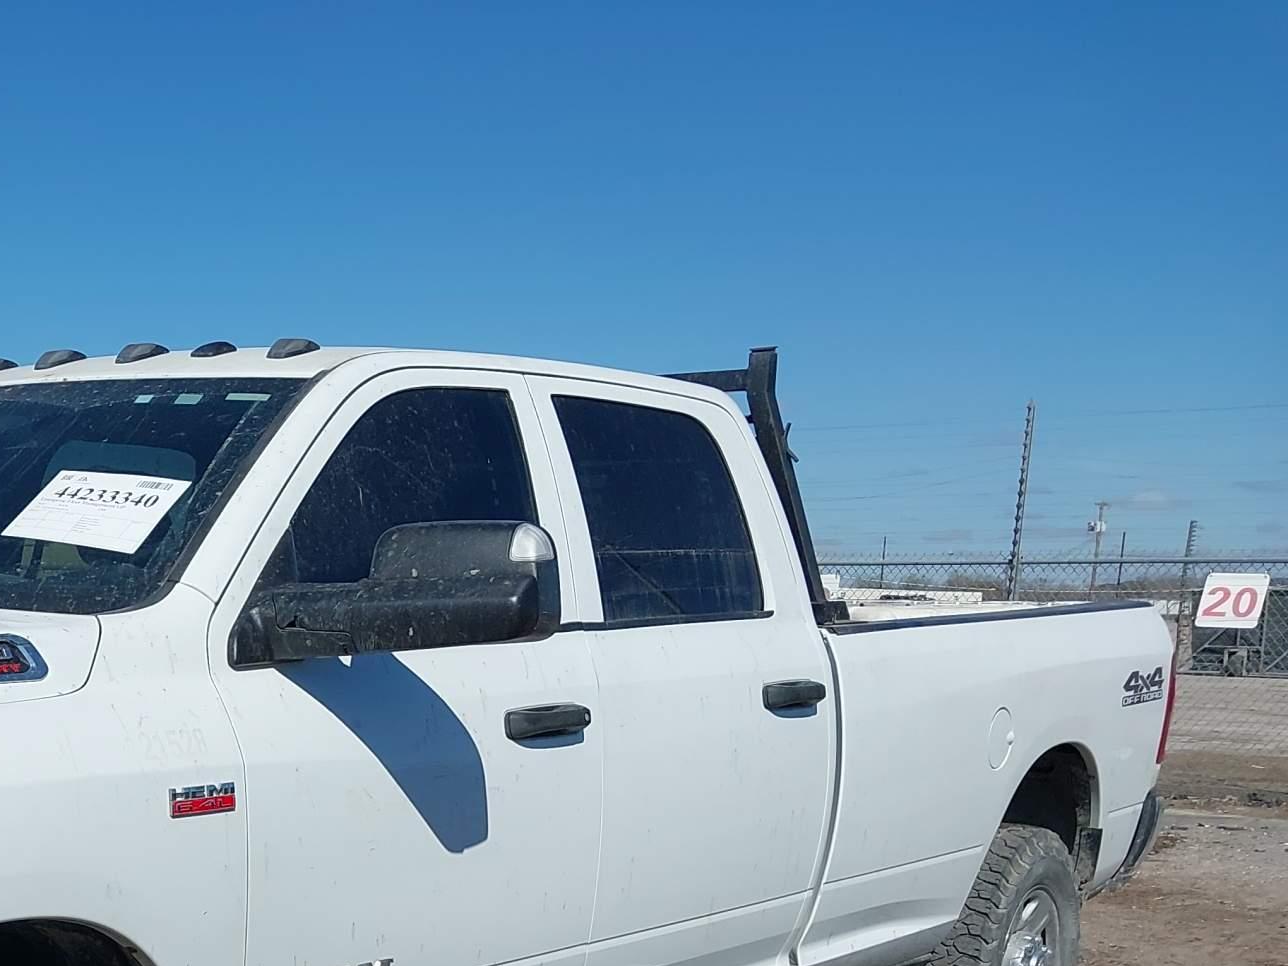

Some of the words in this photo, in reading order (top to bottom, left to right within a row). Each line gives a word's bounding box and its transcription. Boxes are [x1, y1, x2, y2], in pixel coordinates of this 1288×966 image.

[54, 486, 160, 509] 44233340
[1202, 586, 1258, 618] 20
[1123, 694, 1142, 706] OFF
[169, 782, 235, 801] HEMI
